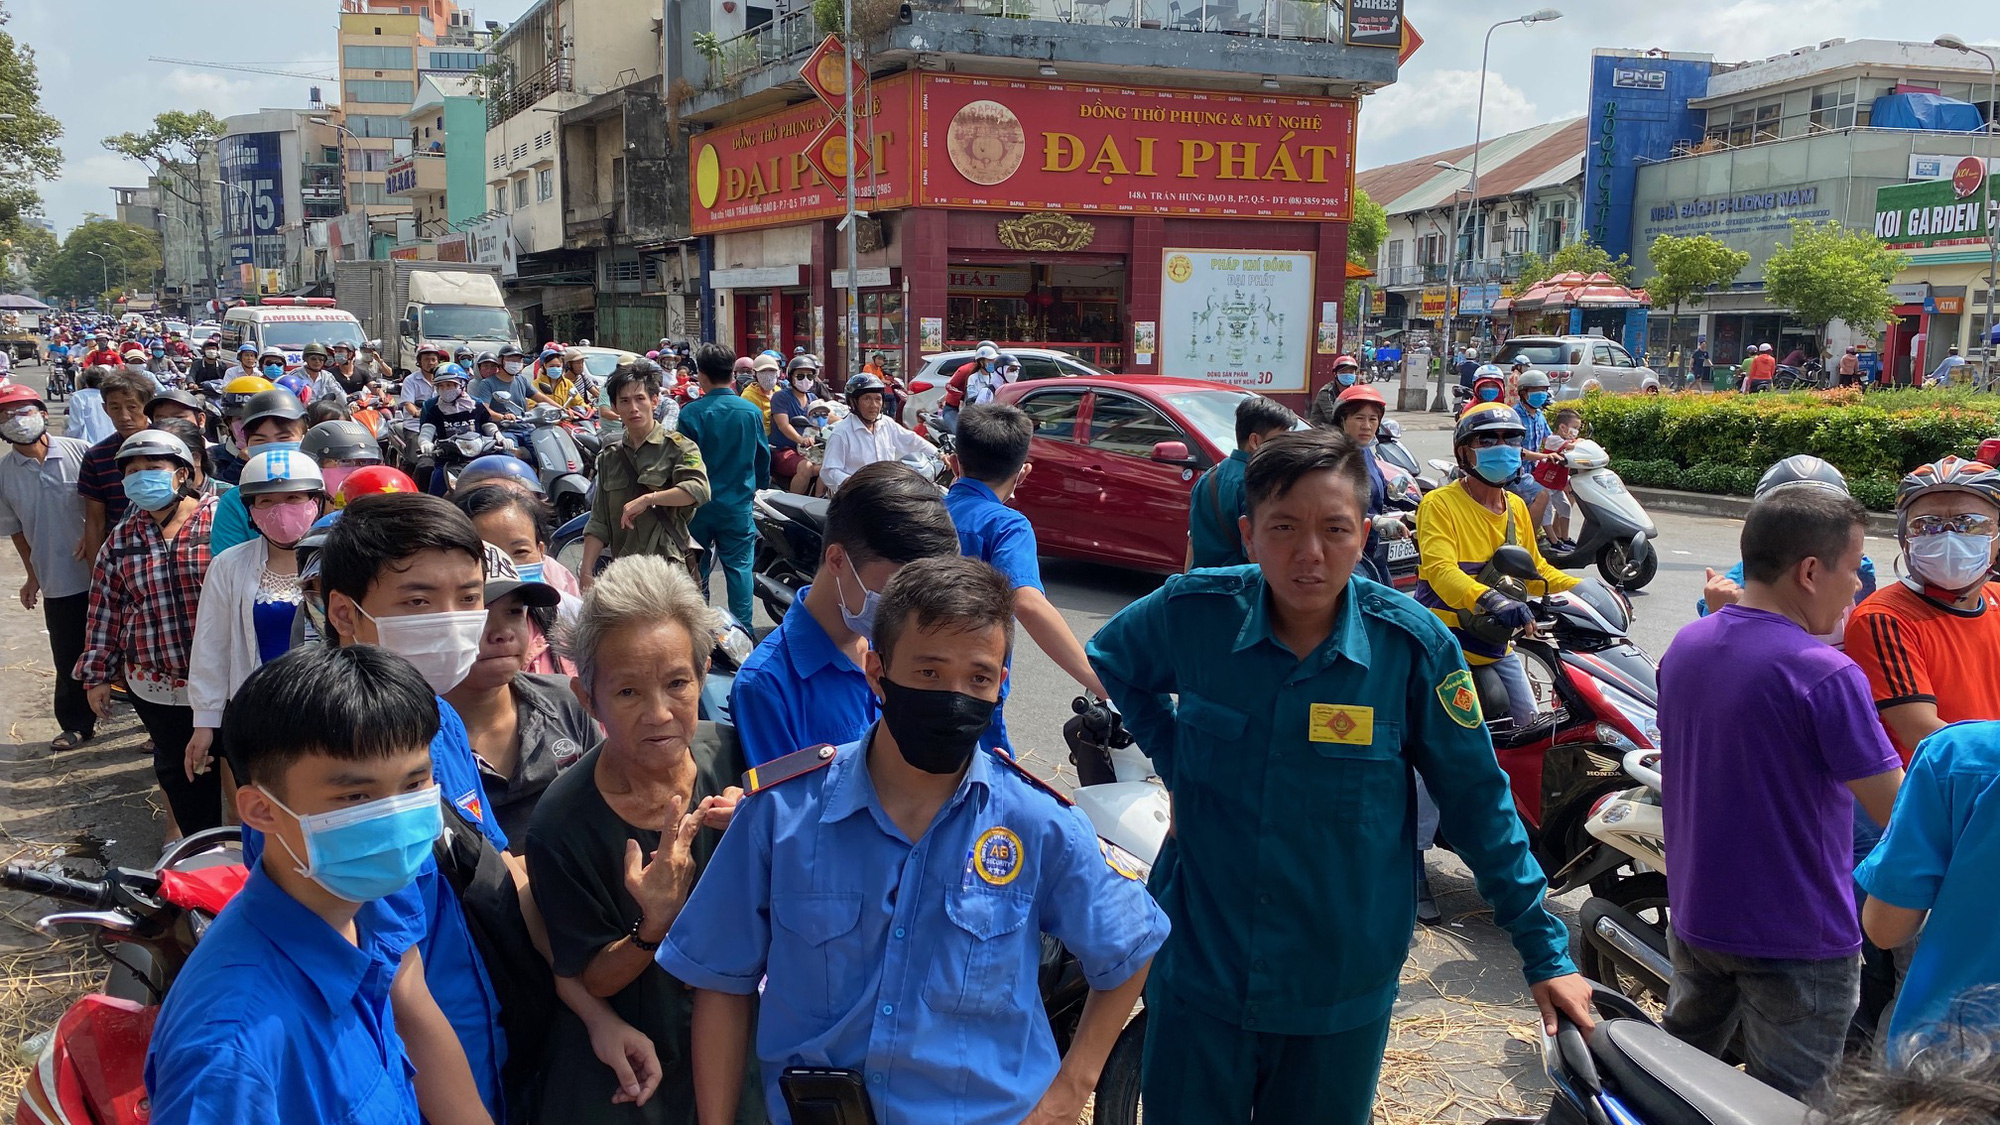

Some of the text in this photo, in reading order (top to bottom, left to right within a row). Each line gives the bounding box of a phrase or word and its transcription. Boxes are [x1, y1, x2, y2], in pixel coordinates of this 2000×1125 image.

[1080, 99, 1323, 133] ĐỒNG THỜ PHỤNG & MỸ NGHỆ
[732, 129, 756, 150] ĐỒNG
[760, 123, 778, 144] THỜ
[780, 115, 814, 139] PHỤNG
[816, 115, 826, 130] &
[1597, 101, 1617, 168] BOOK
[1041, 131, 1159, 185] ĐẠI
[1177, 130, 1337, 183] PHÁT
[725, 156, 782, 203] ĐẠI
[807, 194, 820, 206] HCM
[1128, 191, 1147, 200] 148A
[1288, 196, 1302, 206] (08)
[1302, 196, 1321, 206] 3859
[1321, 197, 1339, 206] 2985
[1650, 200, 1678, 222] NHÀ
[1681, 199, 1717, 219] SÁCH
[1777, 187, 1817, 207] NAM
[1874, 210, 1902, 239] KOI
[1907, 202, 1980, 237] GARDEN
[1210, 256, 1293, 272] PHÁP KHÍ ĐỒNG
[1227, 273, 1276, 288] ĐẠI PHÁT
[1940, 301, 1957, 311] ATM
[1257, 371, 1273, 385] 3D
[235, 393, 251, 403] be
[1492, 407, 1512, 419] be
[990, 844, 1009, 860] AB
